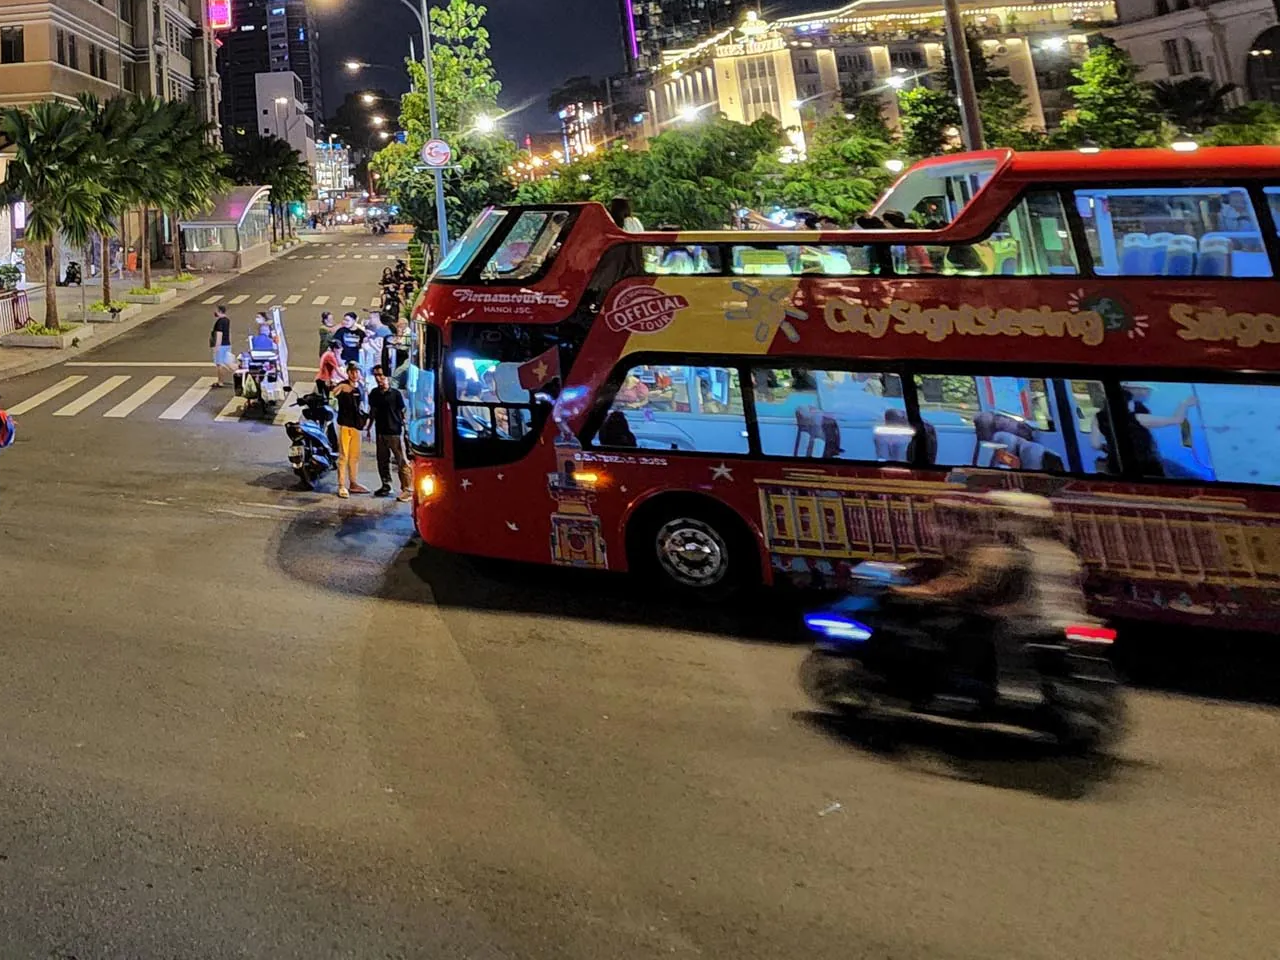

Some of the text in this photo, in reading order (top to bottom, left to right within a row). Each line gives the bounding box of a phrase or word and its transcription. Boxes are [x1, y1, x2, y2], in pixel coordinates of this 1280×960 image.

[483, 306, 512, 314] HANOI
[613, 297, 685, 326] OFFICIAL
[640, 315, 672, 331] TOUR
